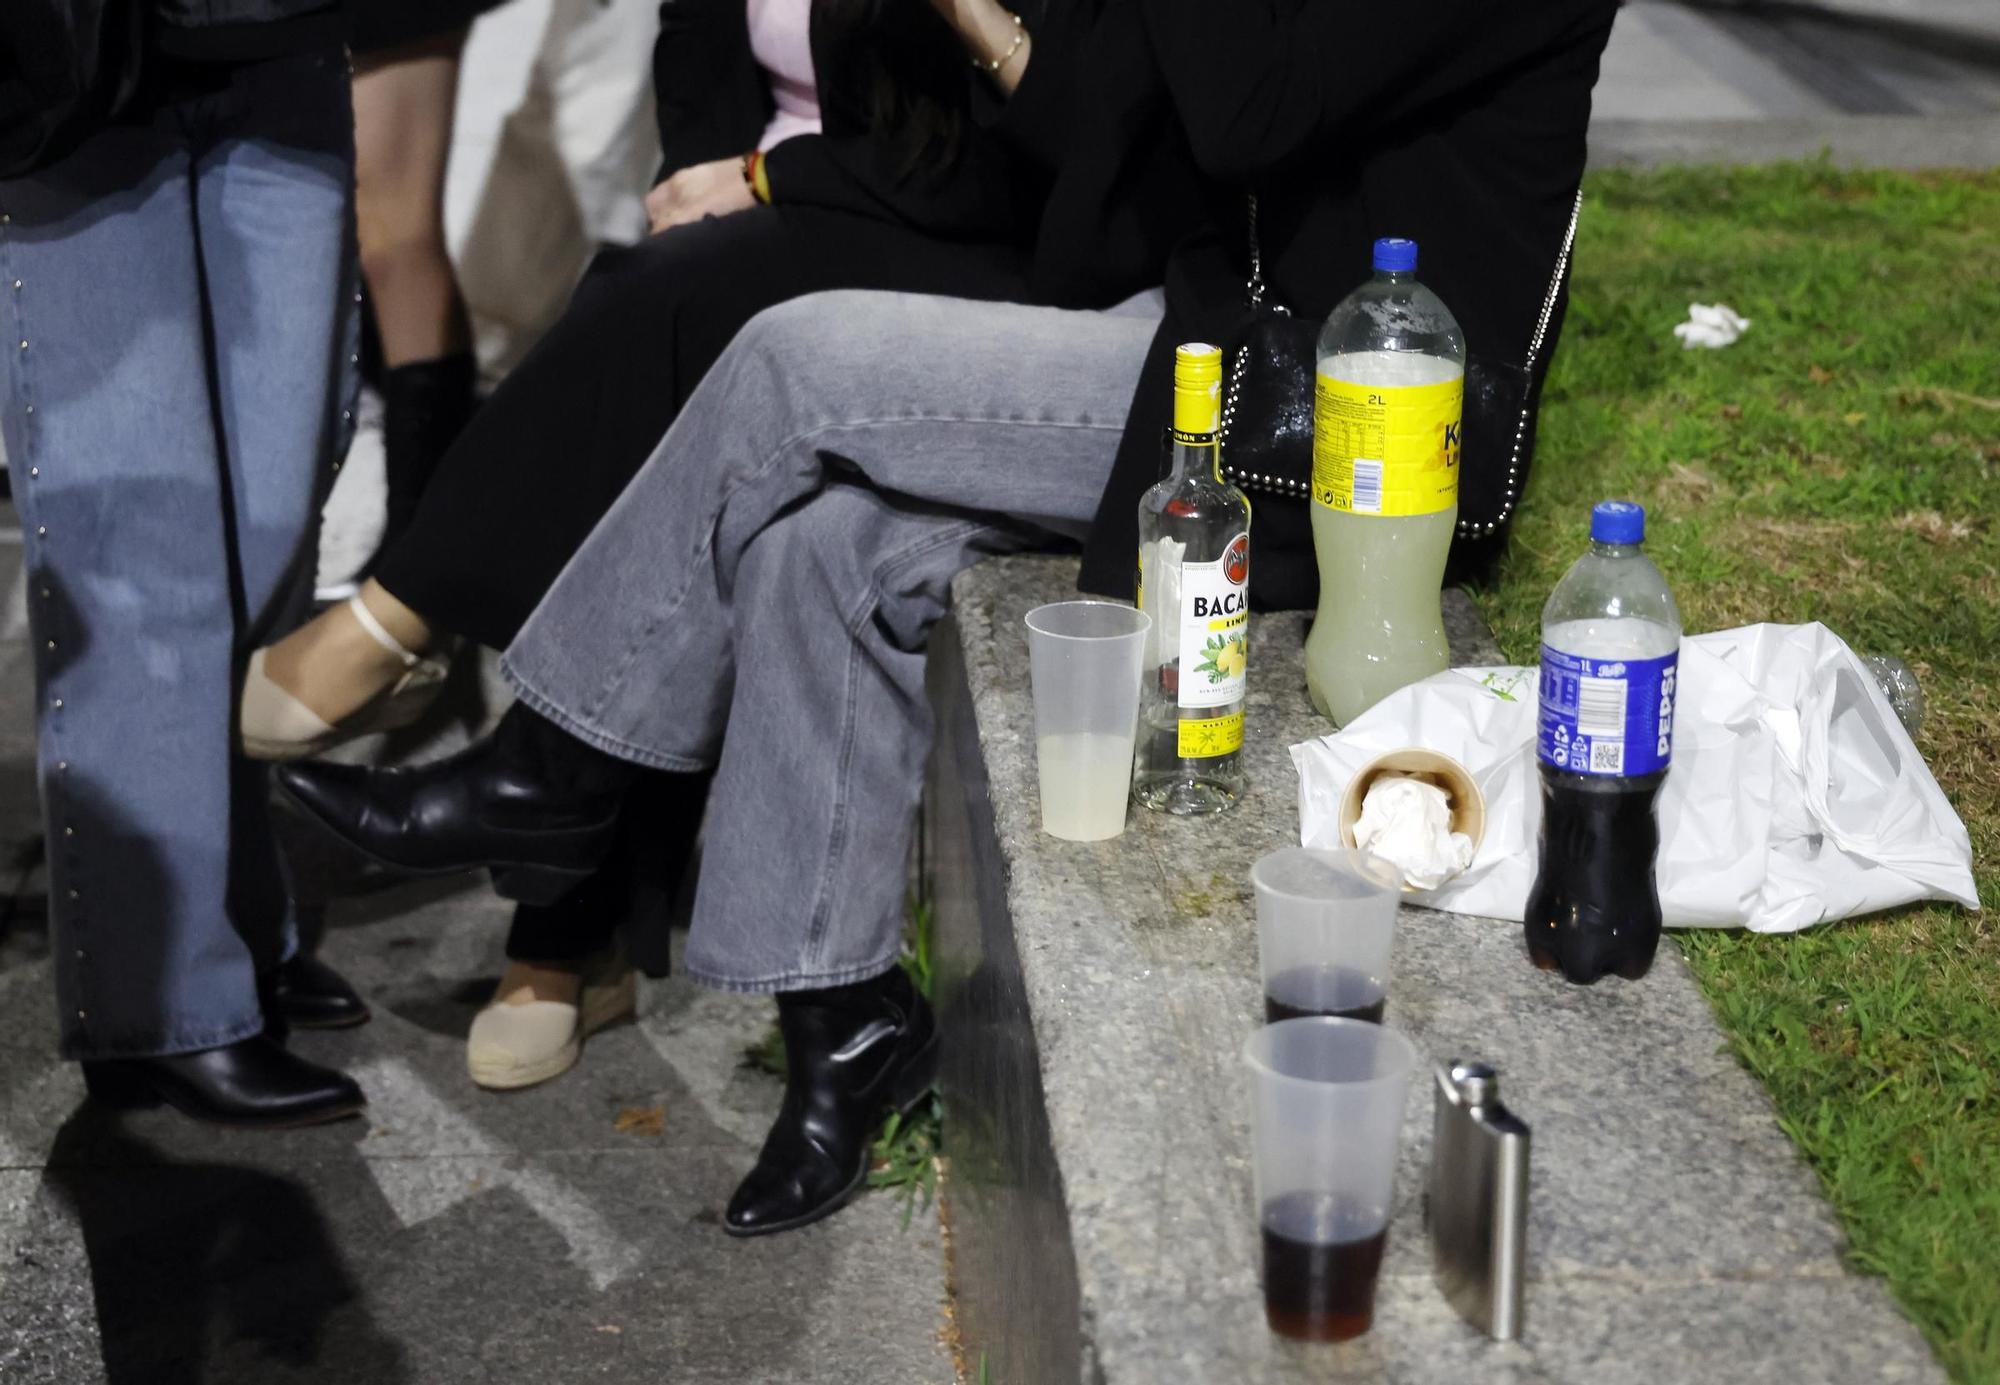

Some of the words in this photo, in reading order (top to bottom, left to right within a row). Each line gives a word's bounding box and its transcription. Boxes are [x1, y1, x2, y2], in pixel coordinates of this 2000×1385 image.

[1368, 394, 1387, 406] 2L
[1173, 432, 1195, 442] IMÓN
[1444, 420, 1461, 450] K
[1580, 659, 1592, 673] 1L
[1656, 665, 1676, 757] PEPSI
